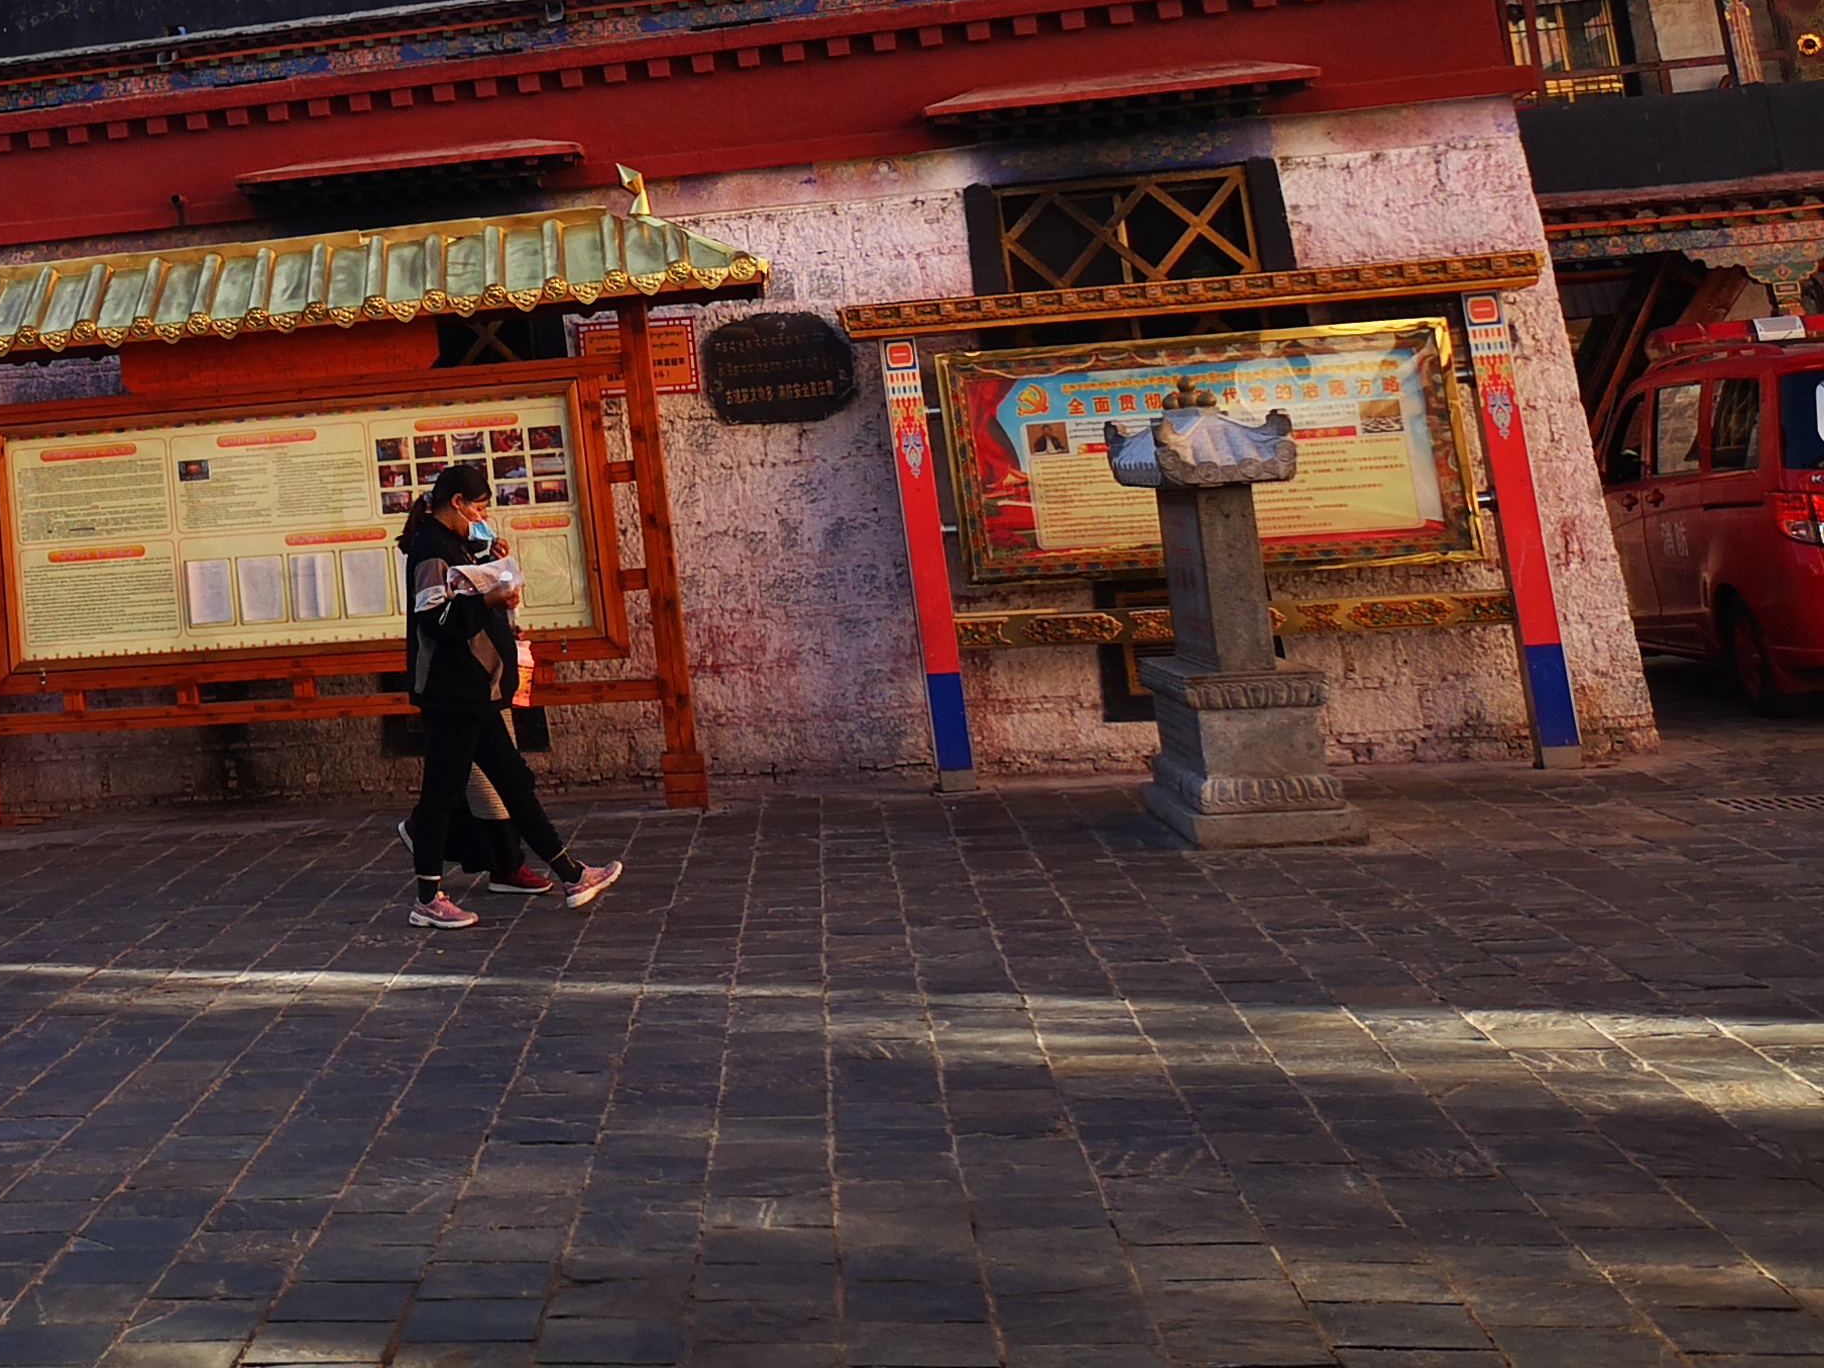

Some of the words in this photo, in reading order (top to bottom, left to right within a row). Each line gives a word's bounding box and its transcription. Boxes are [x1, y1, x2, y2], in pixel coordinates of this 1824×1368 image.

[1067, 374, 1402, 416] 全面贯彻代党的治藏方略
